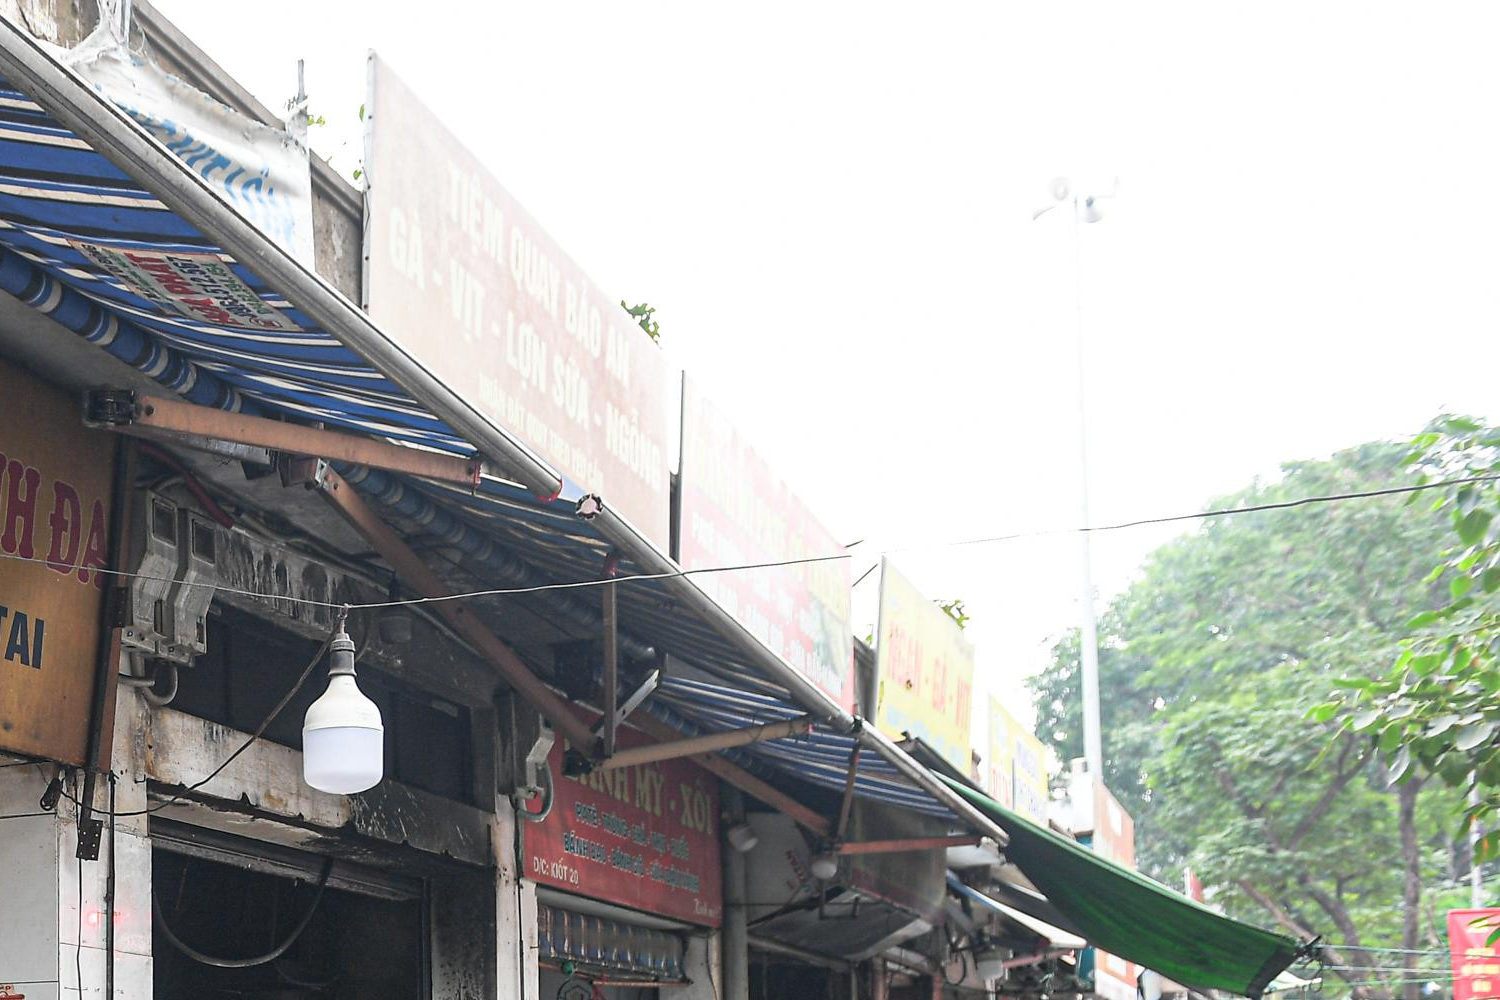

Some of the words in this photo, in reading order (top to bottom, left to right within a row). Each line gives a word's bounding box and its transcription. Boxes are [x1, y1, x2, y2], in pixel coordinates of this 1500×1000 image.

[388, 207, 426, 290] GÀ
[449, 257, 486, 344] VỊT
[505, 308, 548, 393] LỢN
[446, 158, 505, 266] TIỆM
[510, 224, 561, 321] QUAY
